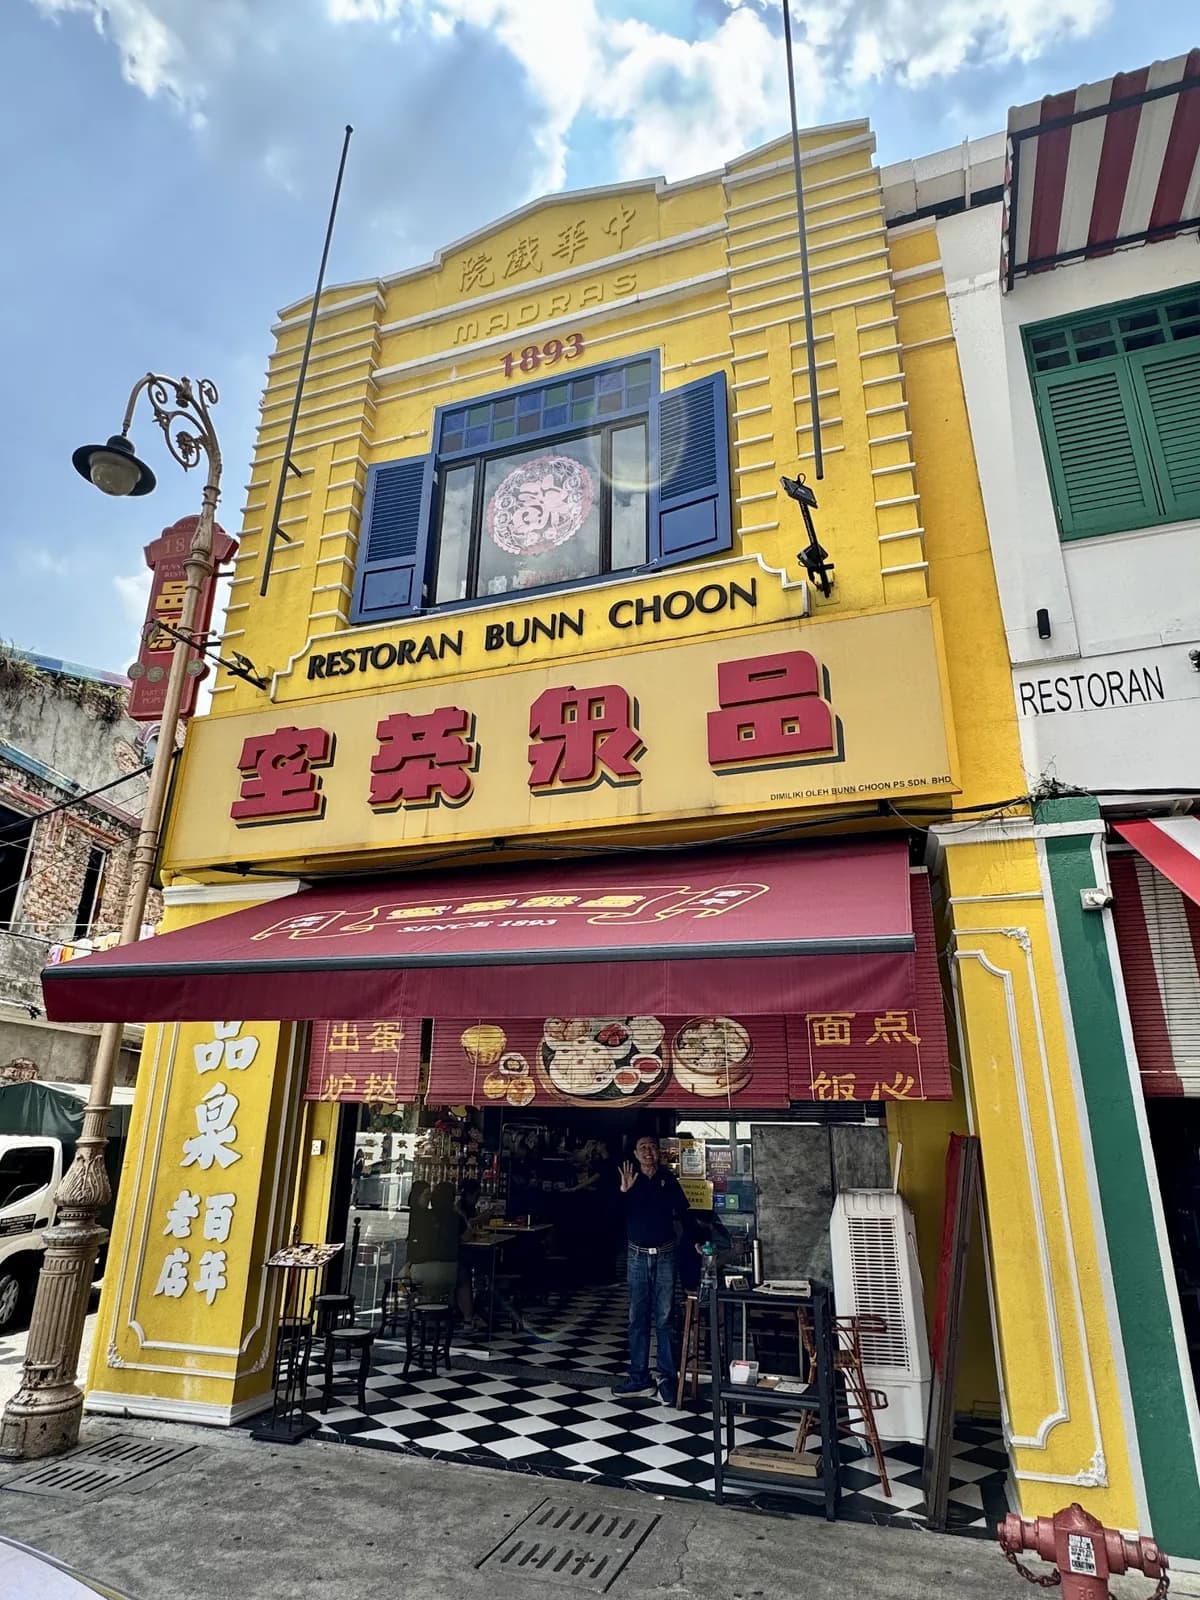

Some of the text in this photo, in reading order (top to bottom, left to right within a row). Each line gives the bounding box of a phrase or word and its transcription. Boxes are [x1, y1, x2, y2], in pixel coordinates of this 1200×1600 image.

[453, 272, 638, 344] MADRAS
[499, 332, 587, 379] 1893
[306, 579, 758, 681] RESTORAN BUNN CHOON
[1019, 665, 1165, 715] RESTORAN
[770, 791, 804, 801] DIMILIKI
[805, 787, 829, 797] OLEH
[831, 785, 856, 795] BUNN
[858, 782, 891, 792] CHOON
[893, 779, 905, 788] PS
[907, 777, 930, 787] SDN.
[396, 918, 558, 933] SINCE 1893
